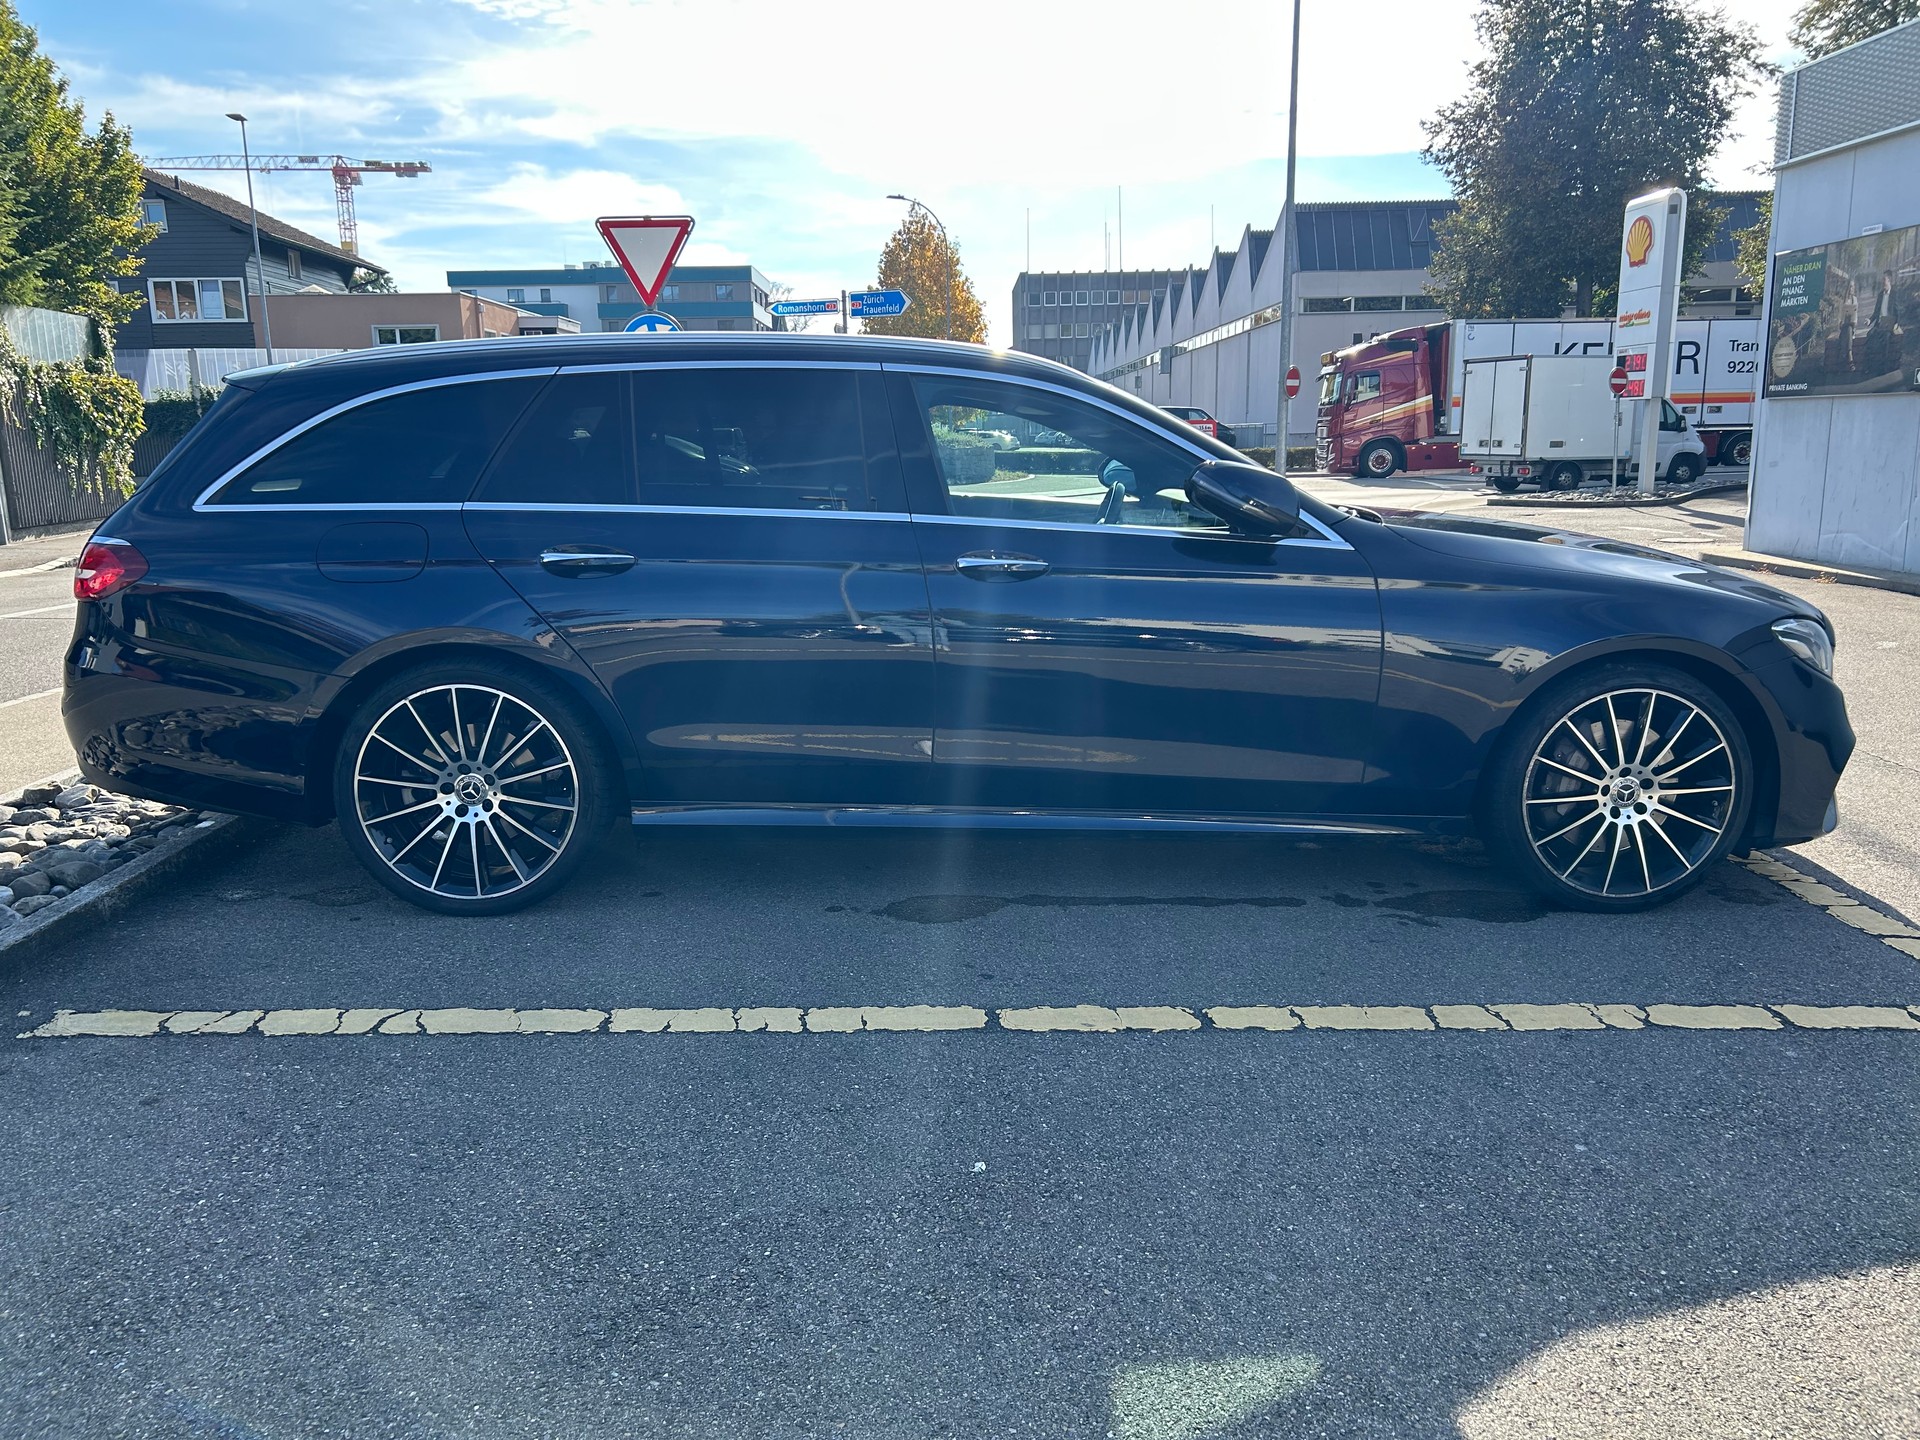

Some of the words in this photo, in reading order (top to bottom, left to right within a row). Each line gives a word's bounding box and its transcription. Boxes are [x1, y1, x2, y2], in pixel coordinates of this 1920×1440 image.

[1783, 264, 1803, 275] NÄHER
[1804, 261, 1822, 271] DRAN
[1782, 277, 1792, 286] AN
[1793, 274, 1806, 284] DEN
[1781, 285, 1806, 296] FINANZ-
[863, 295, 885, 304] Zürich
[1780, 296, 1809, 307] MÄRKTEN
[778, 303, 825, 313] Romanshorn
[863, 304, 900, 314] Frauenfeld
[1786, 383, 1808, 391] BANKING
